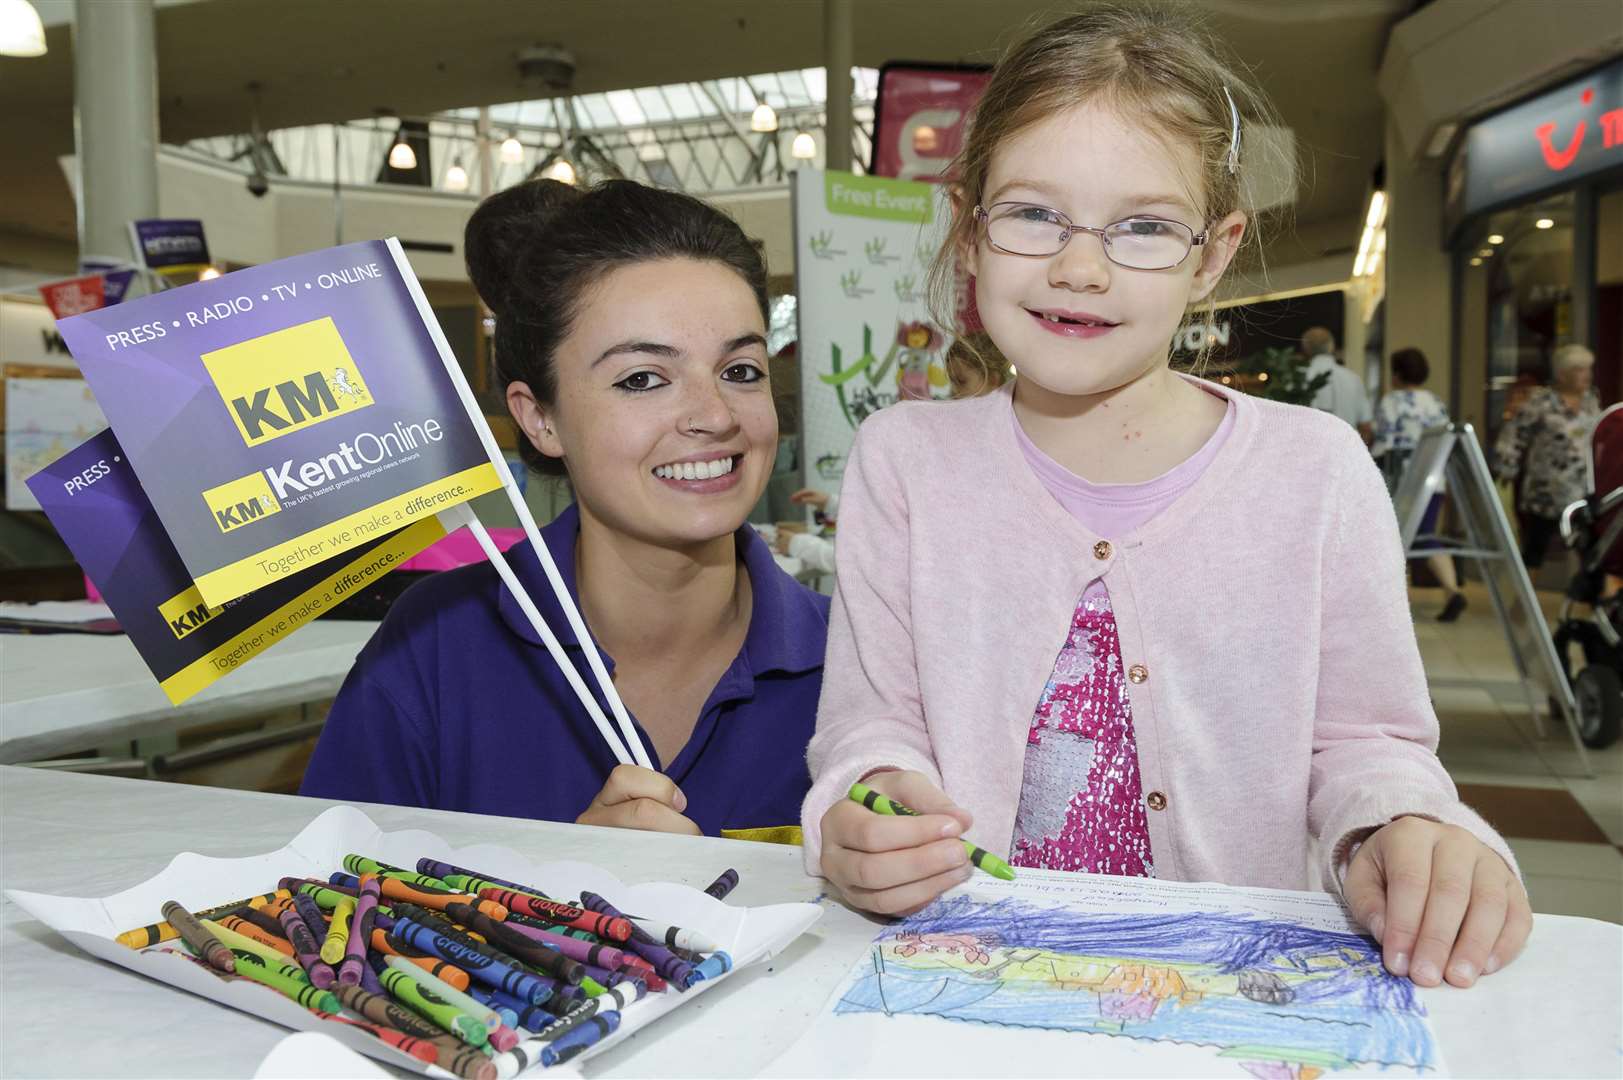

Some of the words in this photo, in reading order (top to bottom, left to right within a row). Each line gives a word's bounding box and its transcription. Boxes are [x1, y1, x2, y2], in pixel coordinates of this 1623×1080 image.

[831, 183, 873, 207] Free
[875, 189, 929, 213] Event
[105, 321, 167, 350] PRESS
[186, 296, 253, 327] RADIO
[271, 282, 297, 302] TV
[318, 263, 382, 289] ONLINE
[231, 371, 339, 440] KM
[63, 460, 111, 496] PRESS
[265, 418, 443, 499] KentOnline
[283, 500, 298, 508] The
[296, 493, 314, 504] UK's
[312, 485, 336, 497] fastest
[335, 475, 360, 490] growing
[359, 466, 384, 479] regional
[383, 461, 399, 470] news
[398, 452, 420, 465] network
[215, 497, 264, 529] KM
[255, 538, 325, 576] Together
[328, 530, 352, 547] we
[353, 512, 391, 538] make
[395, 510, 404, 521] a
[405, 484, 473, 517] difference...
[171, 602, 210, 636] KM
[209, 632, 265, 673] Together
[266, 620, 287, 638] we
[288, 599, 321, 625] make
[323, 593, 333, 603] a
[333, 550, 406, 595] difference...
[531, 899, 582, 919] crayon
[437, 935, 492, 967] crayon
